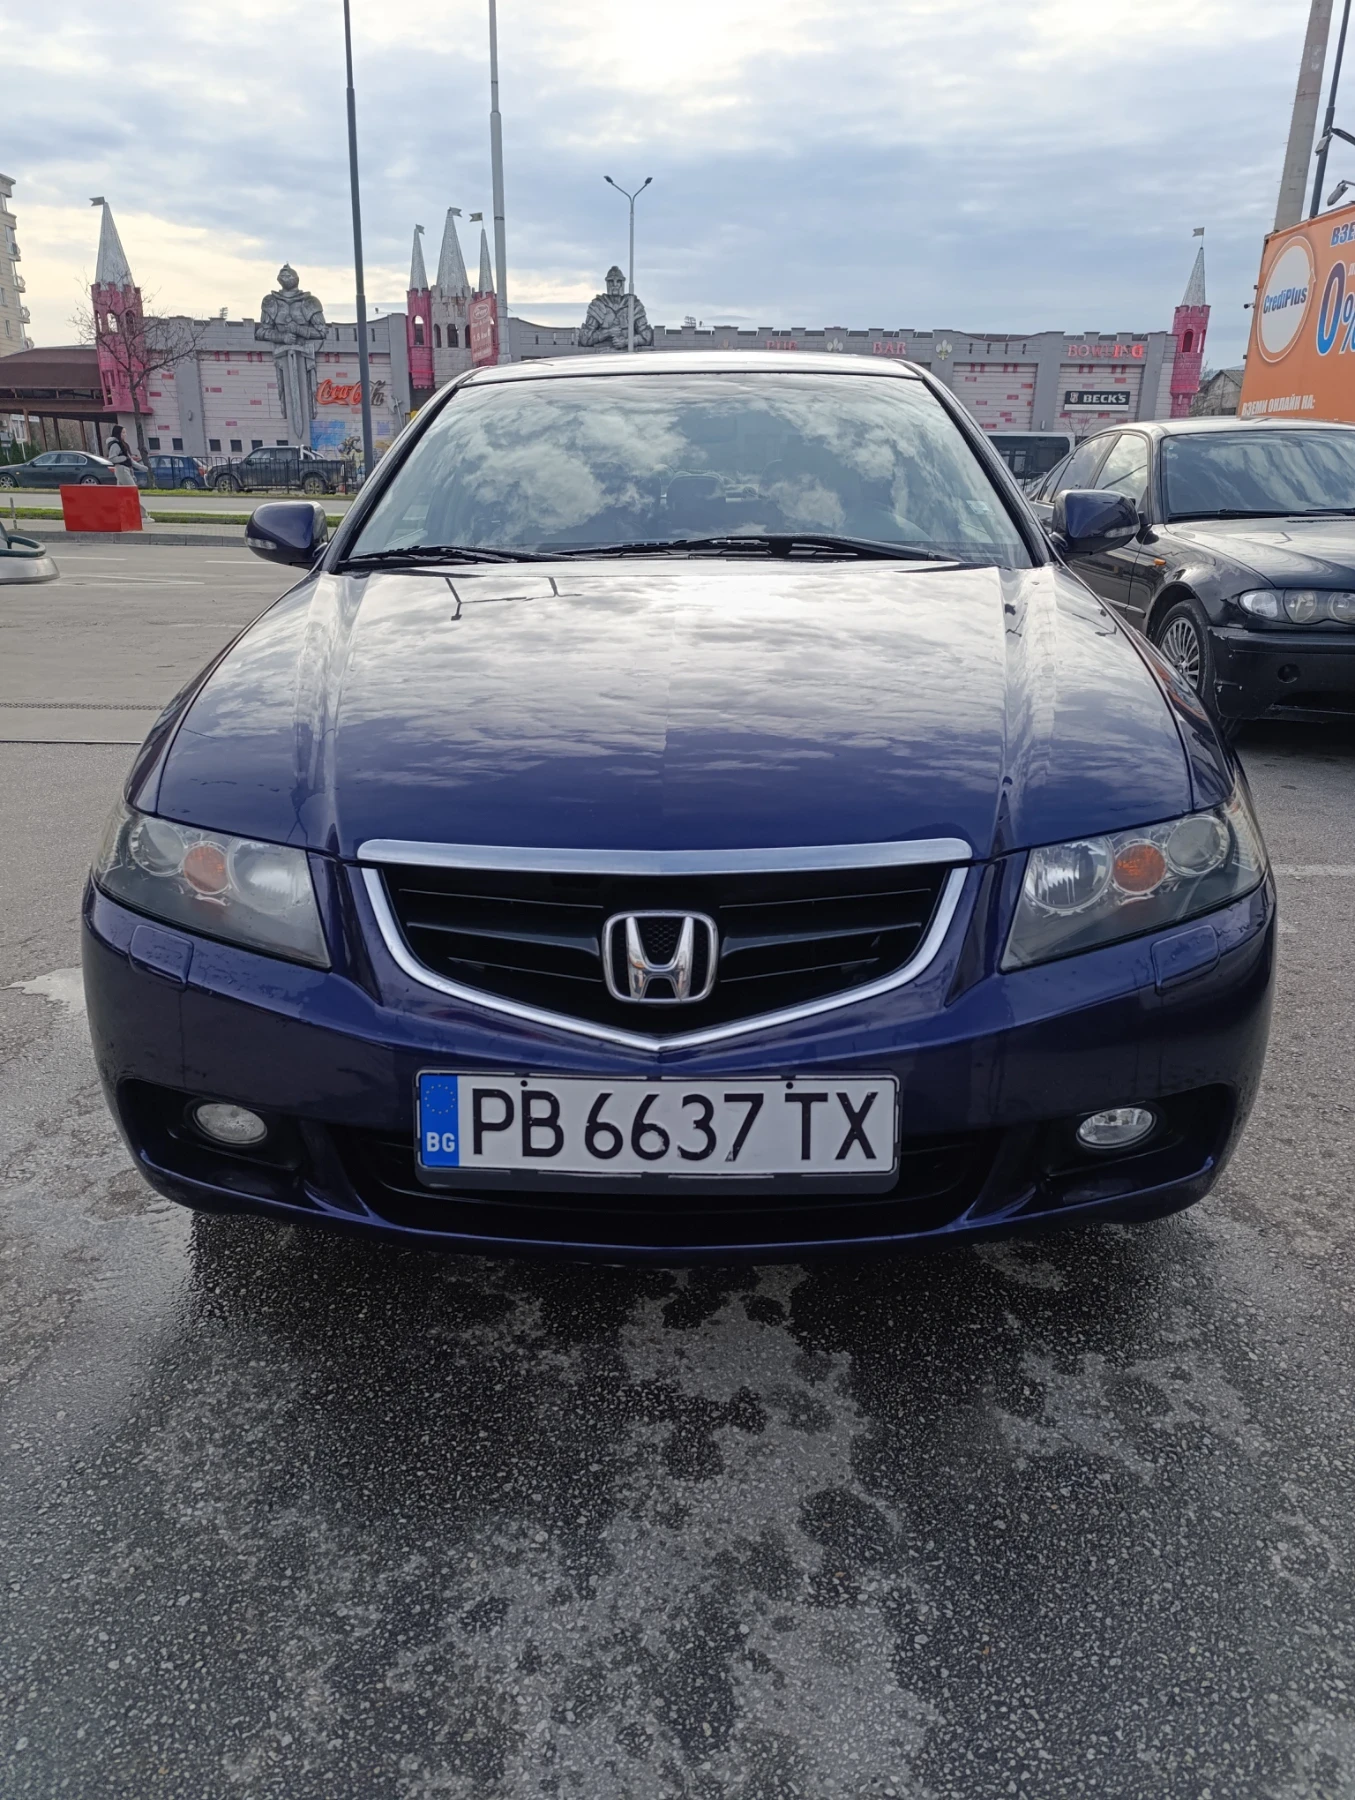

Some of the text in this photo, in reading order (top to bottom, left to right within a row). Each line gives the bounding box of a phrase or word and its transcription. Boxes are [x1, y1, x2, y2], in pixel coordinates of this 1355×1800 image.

[1263, 287, 1308, 314] CrediPlus
[873, 341, 906, 354] BAR
[1068, 344, 1144, 358] BOWLING
[1083, 393, 1127, 403] BECK'S
[1242, 400, 1268, 416] ВЗЕМИ
[1268, 394, 1301, 412] ОНЛАЙН
[472, 1088, 879, 1162] PB 6637 TX
[426, 1131, 455, 1152] BG
